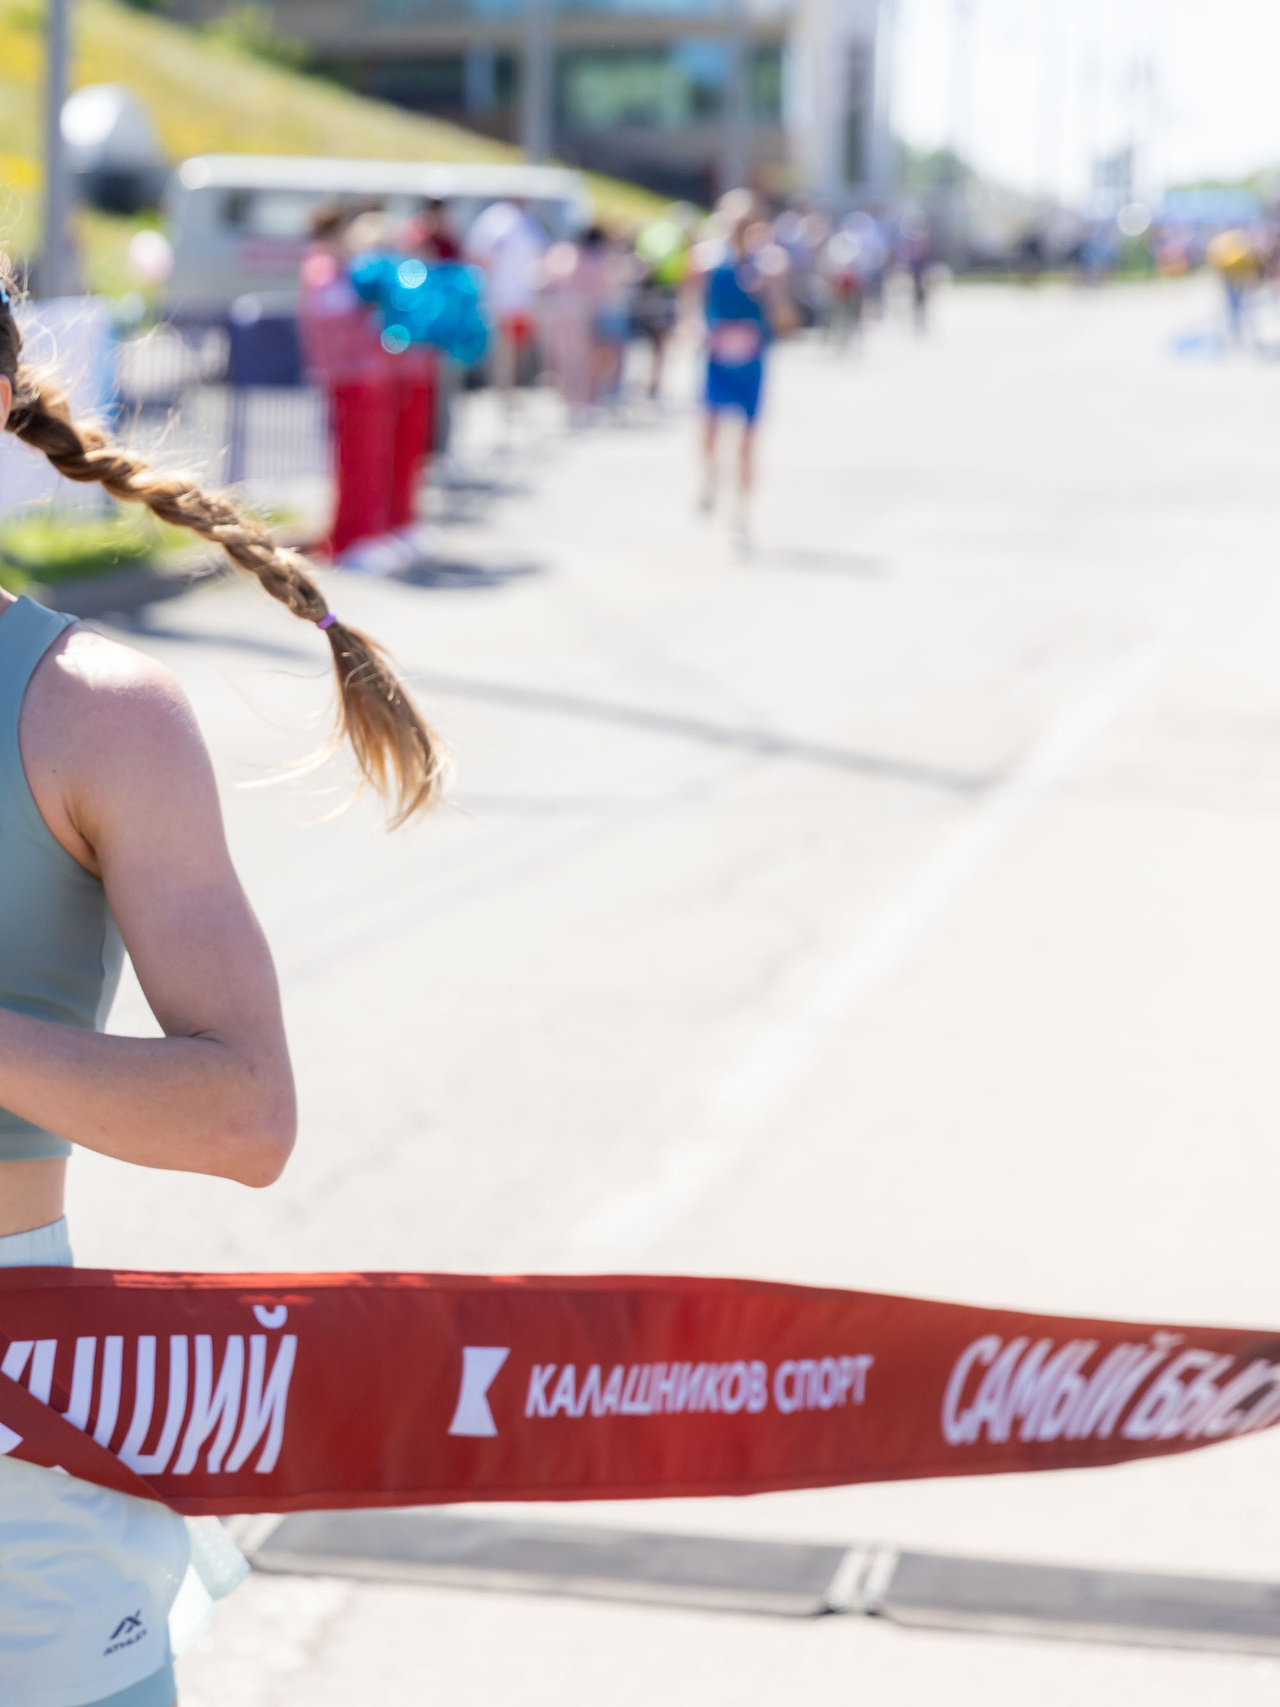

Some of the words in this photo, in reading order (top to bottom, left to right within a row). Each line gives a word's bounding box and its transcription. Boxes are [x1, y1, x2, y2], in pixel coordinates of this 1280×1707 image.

[525, 1361, 768, 1417] КАЛАШНИКОВ
[774, 1354, 875, 1414] СПОРТ
[940, 1330, 1185, 1446] САМЫЙ
